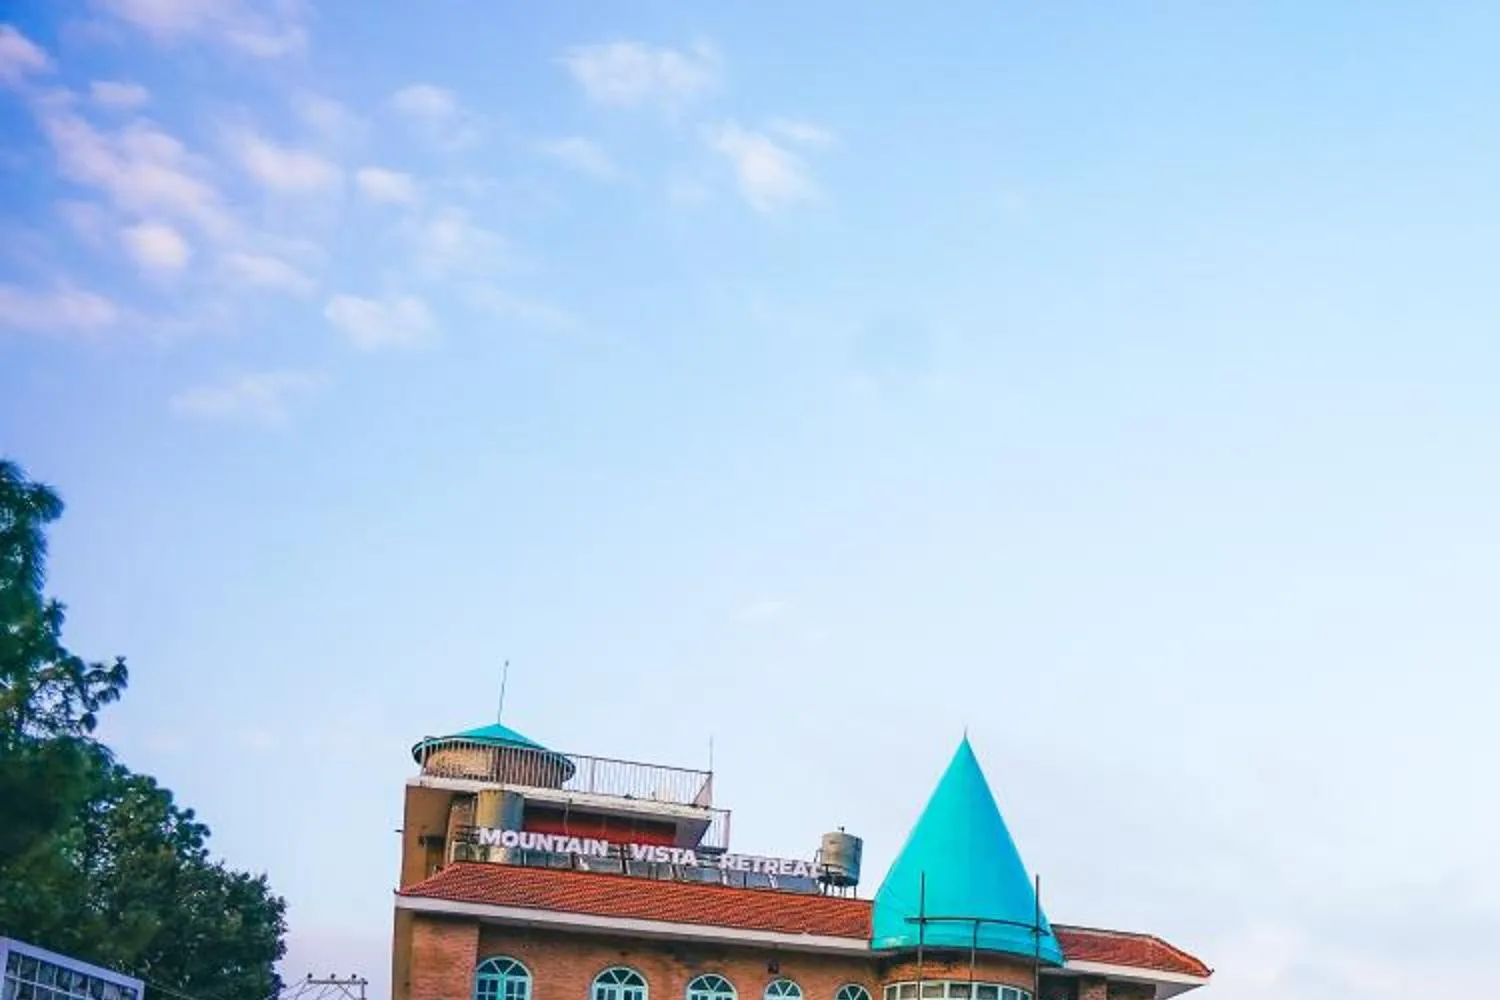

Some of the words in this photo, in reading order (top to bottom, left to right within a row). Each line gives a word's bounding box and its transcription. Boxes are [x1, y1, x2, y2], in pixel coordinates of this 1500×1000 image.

[479, 827, 608, 856] MOUNTAIN
[629, 843, 697, 866] VISTA
[719, 854, 821, 877] RETREAT
